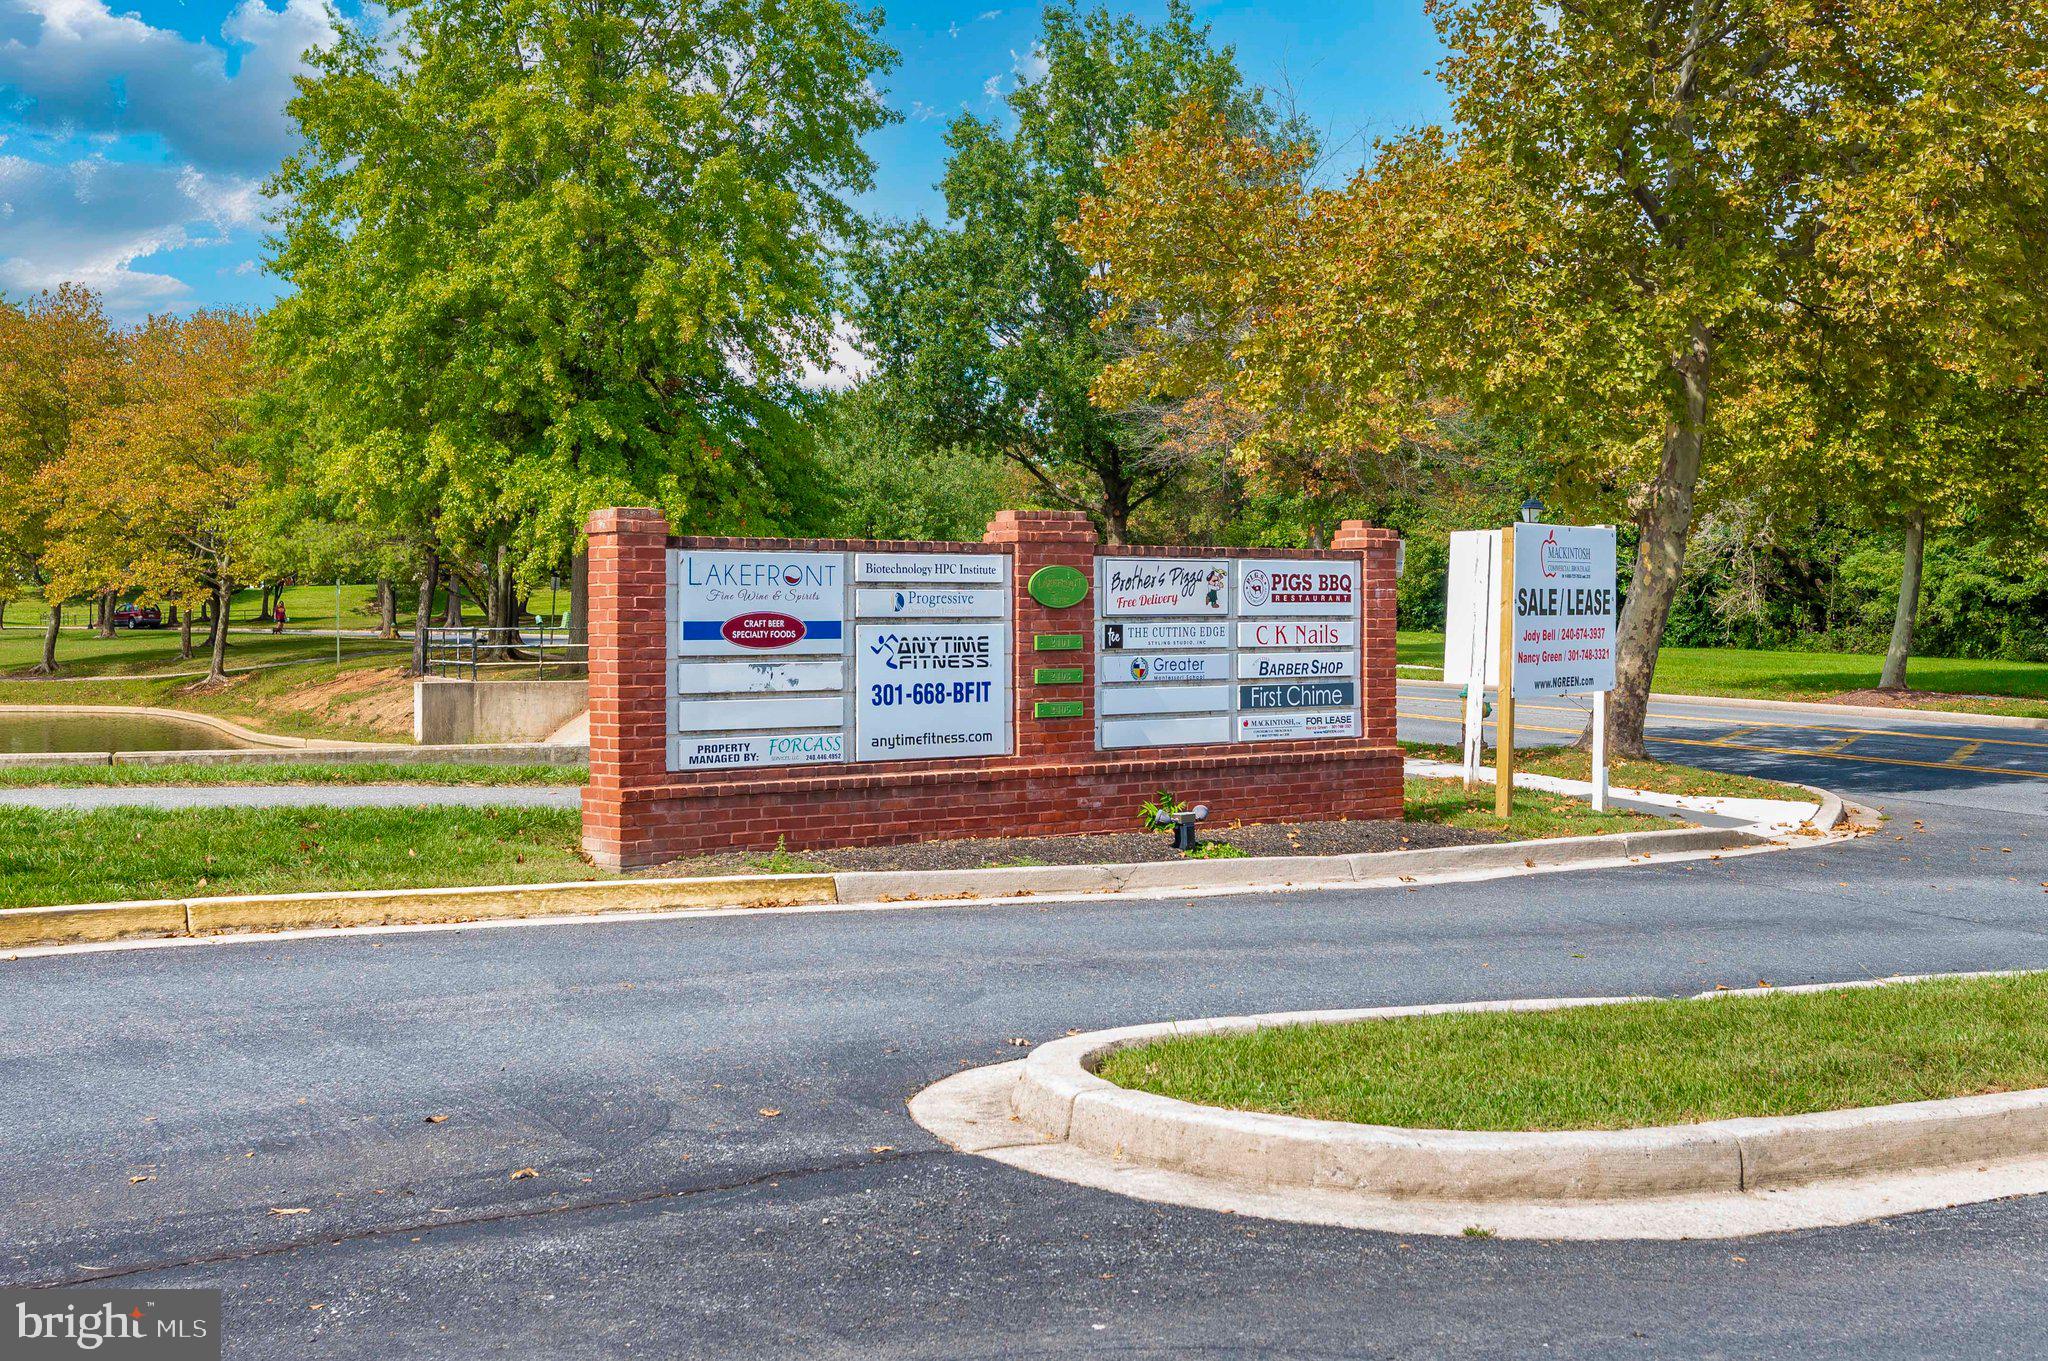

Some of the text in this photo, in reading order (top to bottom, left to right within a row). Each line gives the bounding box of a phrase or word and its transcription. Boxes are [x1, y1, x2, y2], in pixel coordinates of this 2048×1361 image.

[1548, 547, 1590, 560] MACKINTOSH
[688, 557, 836, 587] LAKEFRONT
[866, 563, 996, 576] Biotechnology HPC Institute
[1111, 564, 1204, 598] Brother's Pizza
[1271, 574, 1352, 592] PIGS BBQ
[706, 588, 820, 602] Fine Wine & Spirits
[908, 591, 974, 608] Progressive
[1116, 594, 1178, 608] Free Delivery
[744, 620, 784, 628] CRAFT BEER
[732, 630, 796, 639] SPECIALTY FOODS
[1128, 626, 1226, 638] THE CUTTING EDGE
[1256, 624, 1339, 645] C K Nails
[1523, 630, 1540, 644] Jody
[1542, 630, 1556, 640] Bell
[1562, 628, 1606, 640] 240-674-3937
[897, 636, 989, 654] ANYTIME
[899, 655, 990, 670] FITNESS
[1518, 652, 1540, 666] Nancy
[1542, 650, 1562, 662] Green
[1568, 648, 1610, 661] 301-748-3321
[1154, 658, 1204, 672] Greater
[1534, 676, 1594, 690] www.NGREEN.com
[871, 681, 992, 706] 301-668-BFIT
[1251, 685, 1343, 707] First Chime
[1306, 716, 1352, 726] FOR LEASE
[698, 743, 750, 754] PROPERTY
[770, 736, 842, 756] FORCASS
[871, 732, 992, 750] anytimefitness.com
[689, 752, 759, 764] MANAGED BY:
